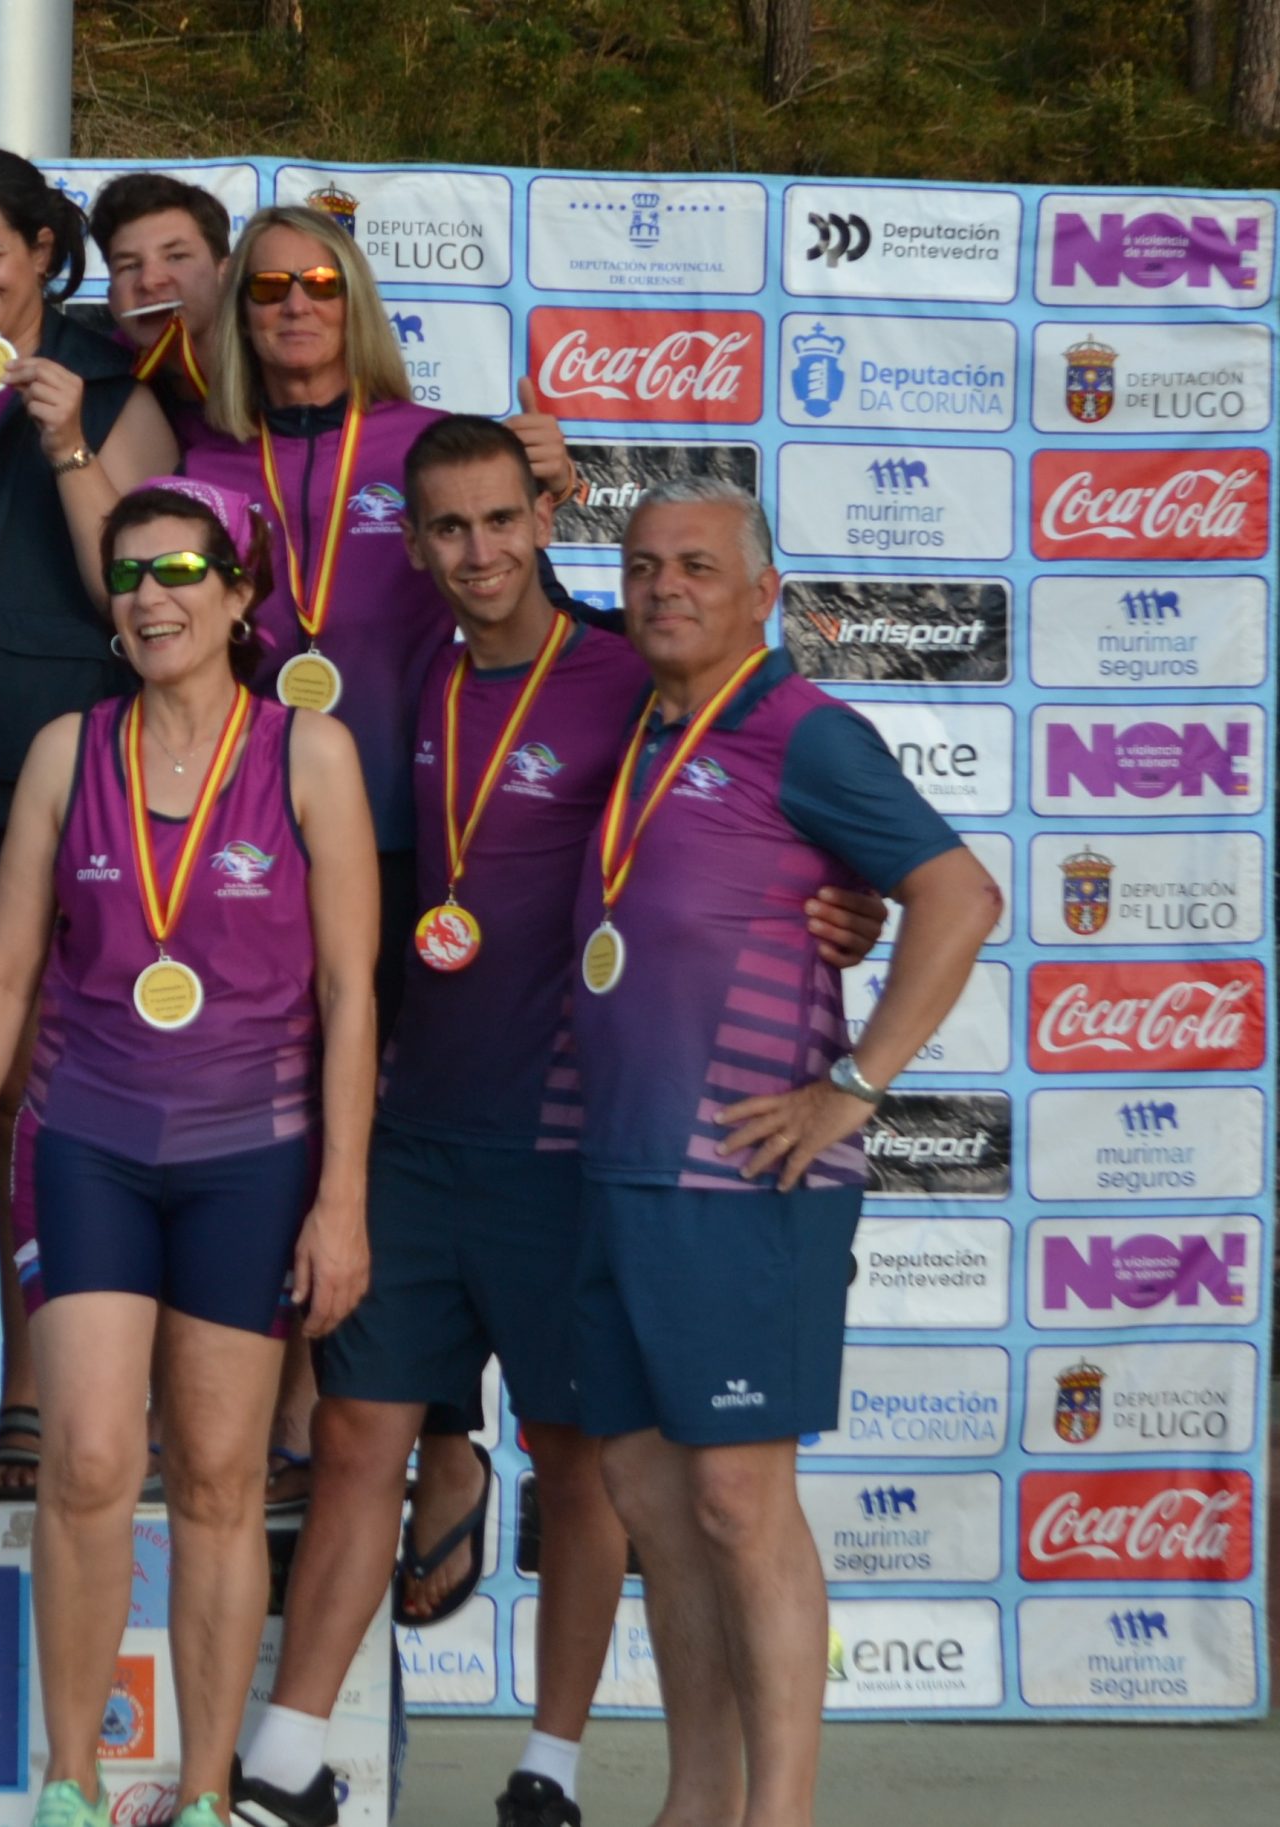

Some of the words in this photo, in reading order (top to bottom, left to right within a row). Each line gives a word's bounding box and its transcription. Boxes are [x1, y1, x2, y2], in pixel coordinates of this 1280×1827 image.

[367, 220, 483, 238] DEPUTACIÓN
[883, 222, 999, 241] Deputación
[367, 241, 390, 256] DE
[395, 242, 484, 271] LUGO
[882, 241, 999, 261] Pontevedra
[570, 258, 647, 272] DEPUTACIÓN
[650, 260, 725, 273] PROVINCIAL
[609, 274, 625, 285] DE
[626, 275, 685, 286] OURENSE
[538, 329, 753, 402] Coca-Cola
[860, 360, 1005, 391] Deputación
[1127, 368, 1244, 387] DEPUTACIÓN
[859, 390, 892, 413] DA
[901, 387, 1003, 416] CORUÑA
[1126, 393, 1149, 408] DE
[1153, 390, 1245, 419] LUGO
[846, 500, 945, 522] murimar
[1041, 468, 1258, 540] Coca-Cola
[847, 526, 945, 549] seguros
[838, 618, 985, 651] infisport
[1098, 632, 1198, 653] murimar
[1099, 657, 1199, 681] seguros
[900, 741, 978, 777] nce
[77, 866, 121, 880] amura
[1121, 881, 1236, 899] DEPUTACIÓN
[1121, 904, 1142, 919] DE
[1145, 902, 1237, 931] LUGO
[1037, 979, 1254, 1053] Coca-Cola
[1097, 1143, 1194, 1165] murimar
[1097, 1169, 1196, 1192] seguros
[870, 1251, 986, 1272] Deputación
[869, 1269, 986, 1289] Pontevedra
[711, 1389, 764, 1408] amura
[851, 1389, 998, 1419] Deputación
[1113, 1389, 1229, 1408] DEPUTACIÓN
[849, 1418, 885, 1442] DA
[891, 1414, 997, 1442] CORUÑA
[1113, 1412, 1137, 1428] DE
[1140, 1411, 1228, 1439] LUGO
[1029, 1489, 1242, 1563] Coca-Cola
[833, 1527, 932, 1549] murimar
[833, 1551, 932, 1575] seguros
[853, 1638, 964, 1673] ence
[1088, 1652, 1186, 1674] murimar
[1089, 1676, 1188, 1700] seguros
